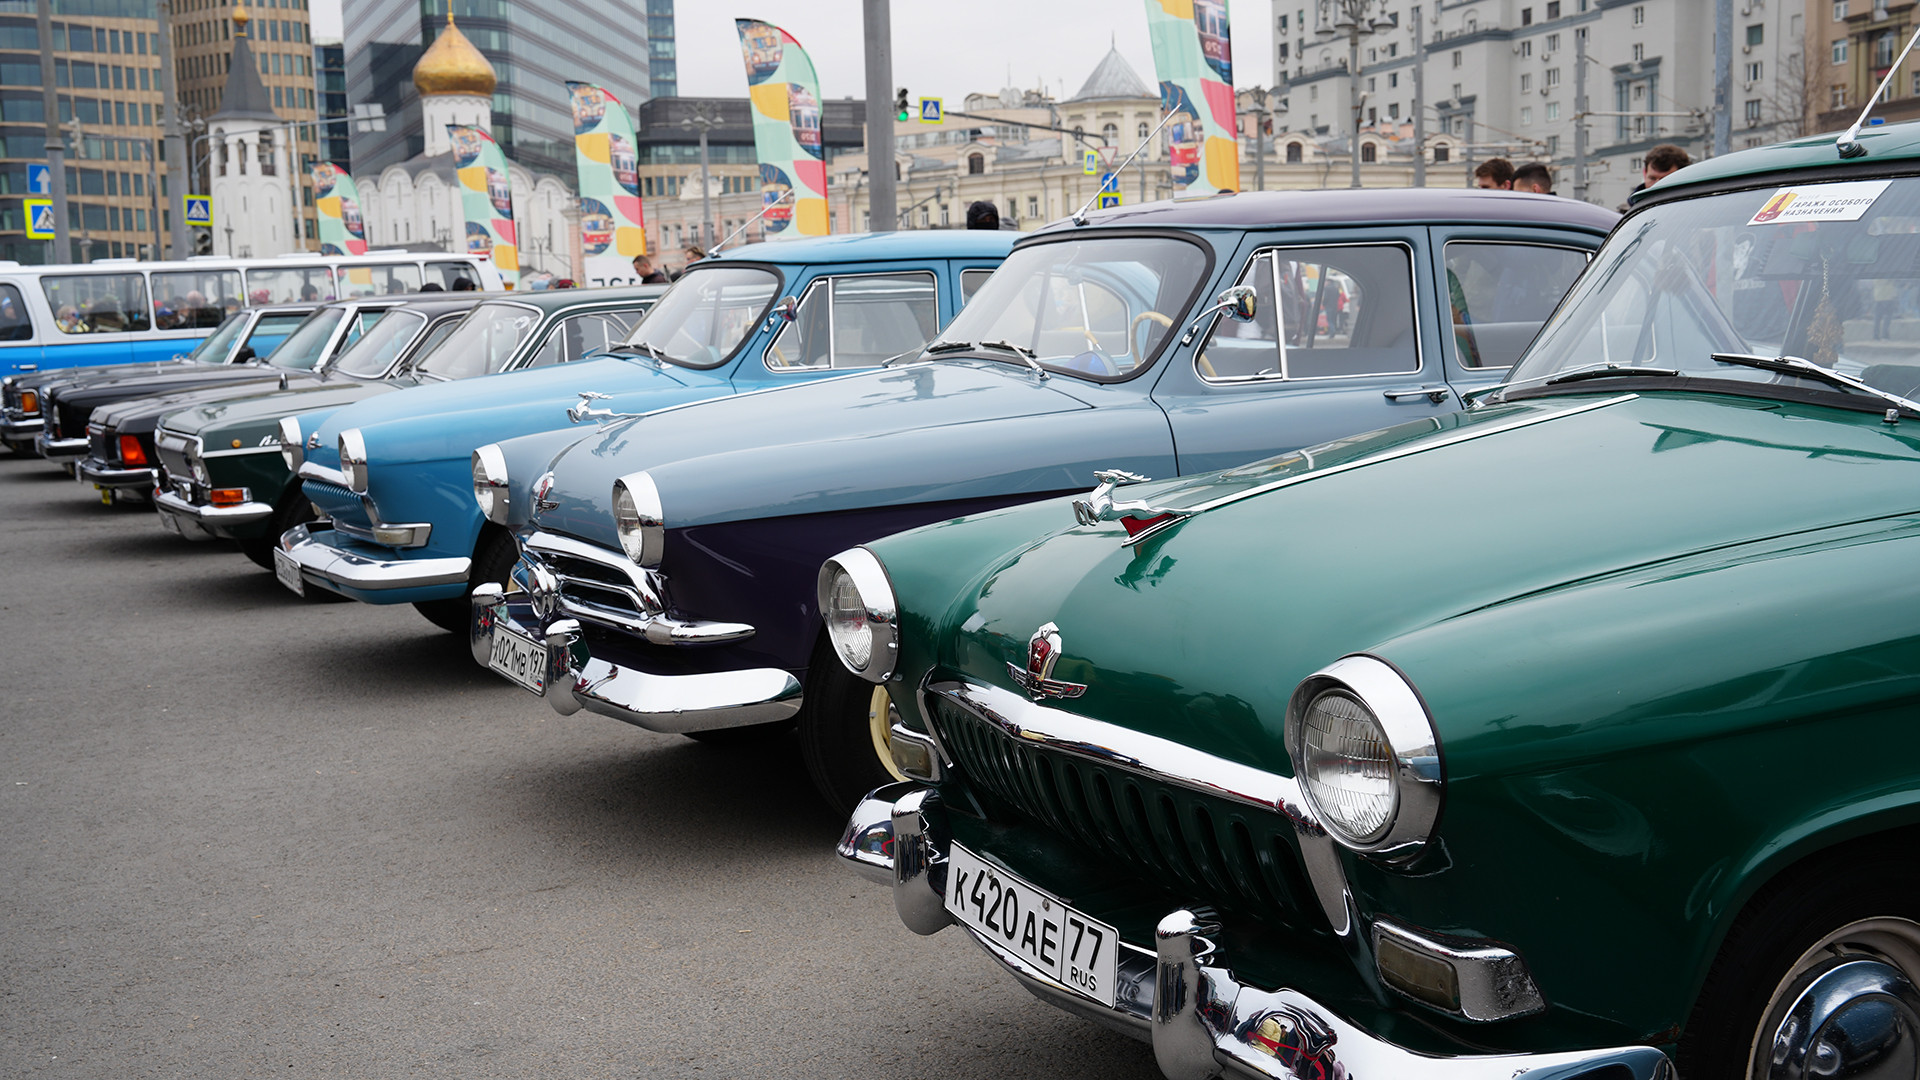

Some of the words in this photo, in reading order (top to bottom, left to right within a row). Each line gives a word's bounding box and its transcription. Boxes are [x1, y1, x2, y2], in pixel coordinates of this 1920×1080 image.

[1784, 207, 1845, 216] НАЗНАЧЕНИЯ
[1790, 200, 1826, 208] ГАРАЖА
[1828, 198, 1873, 206] ОСОБОГО
[530, 649, 545, 675] 197
[1070, 917, 1103, 971] 77
[1070, 966, 1097, 991] RUS
